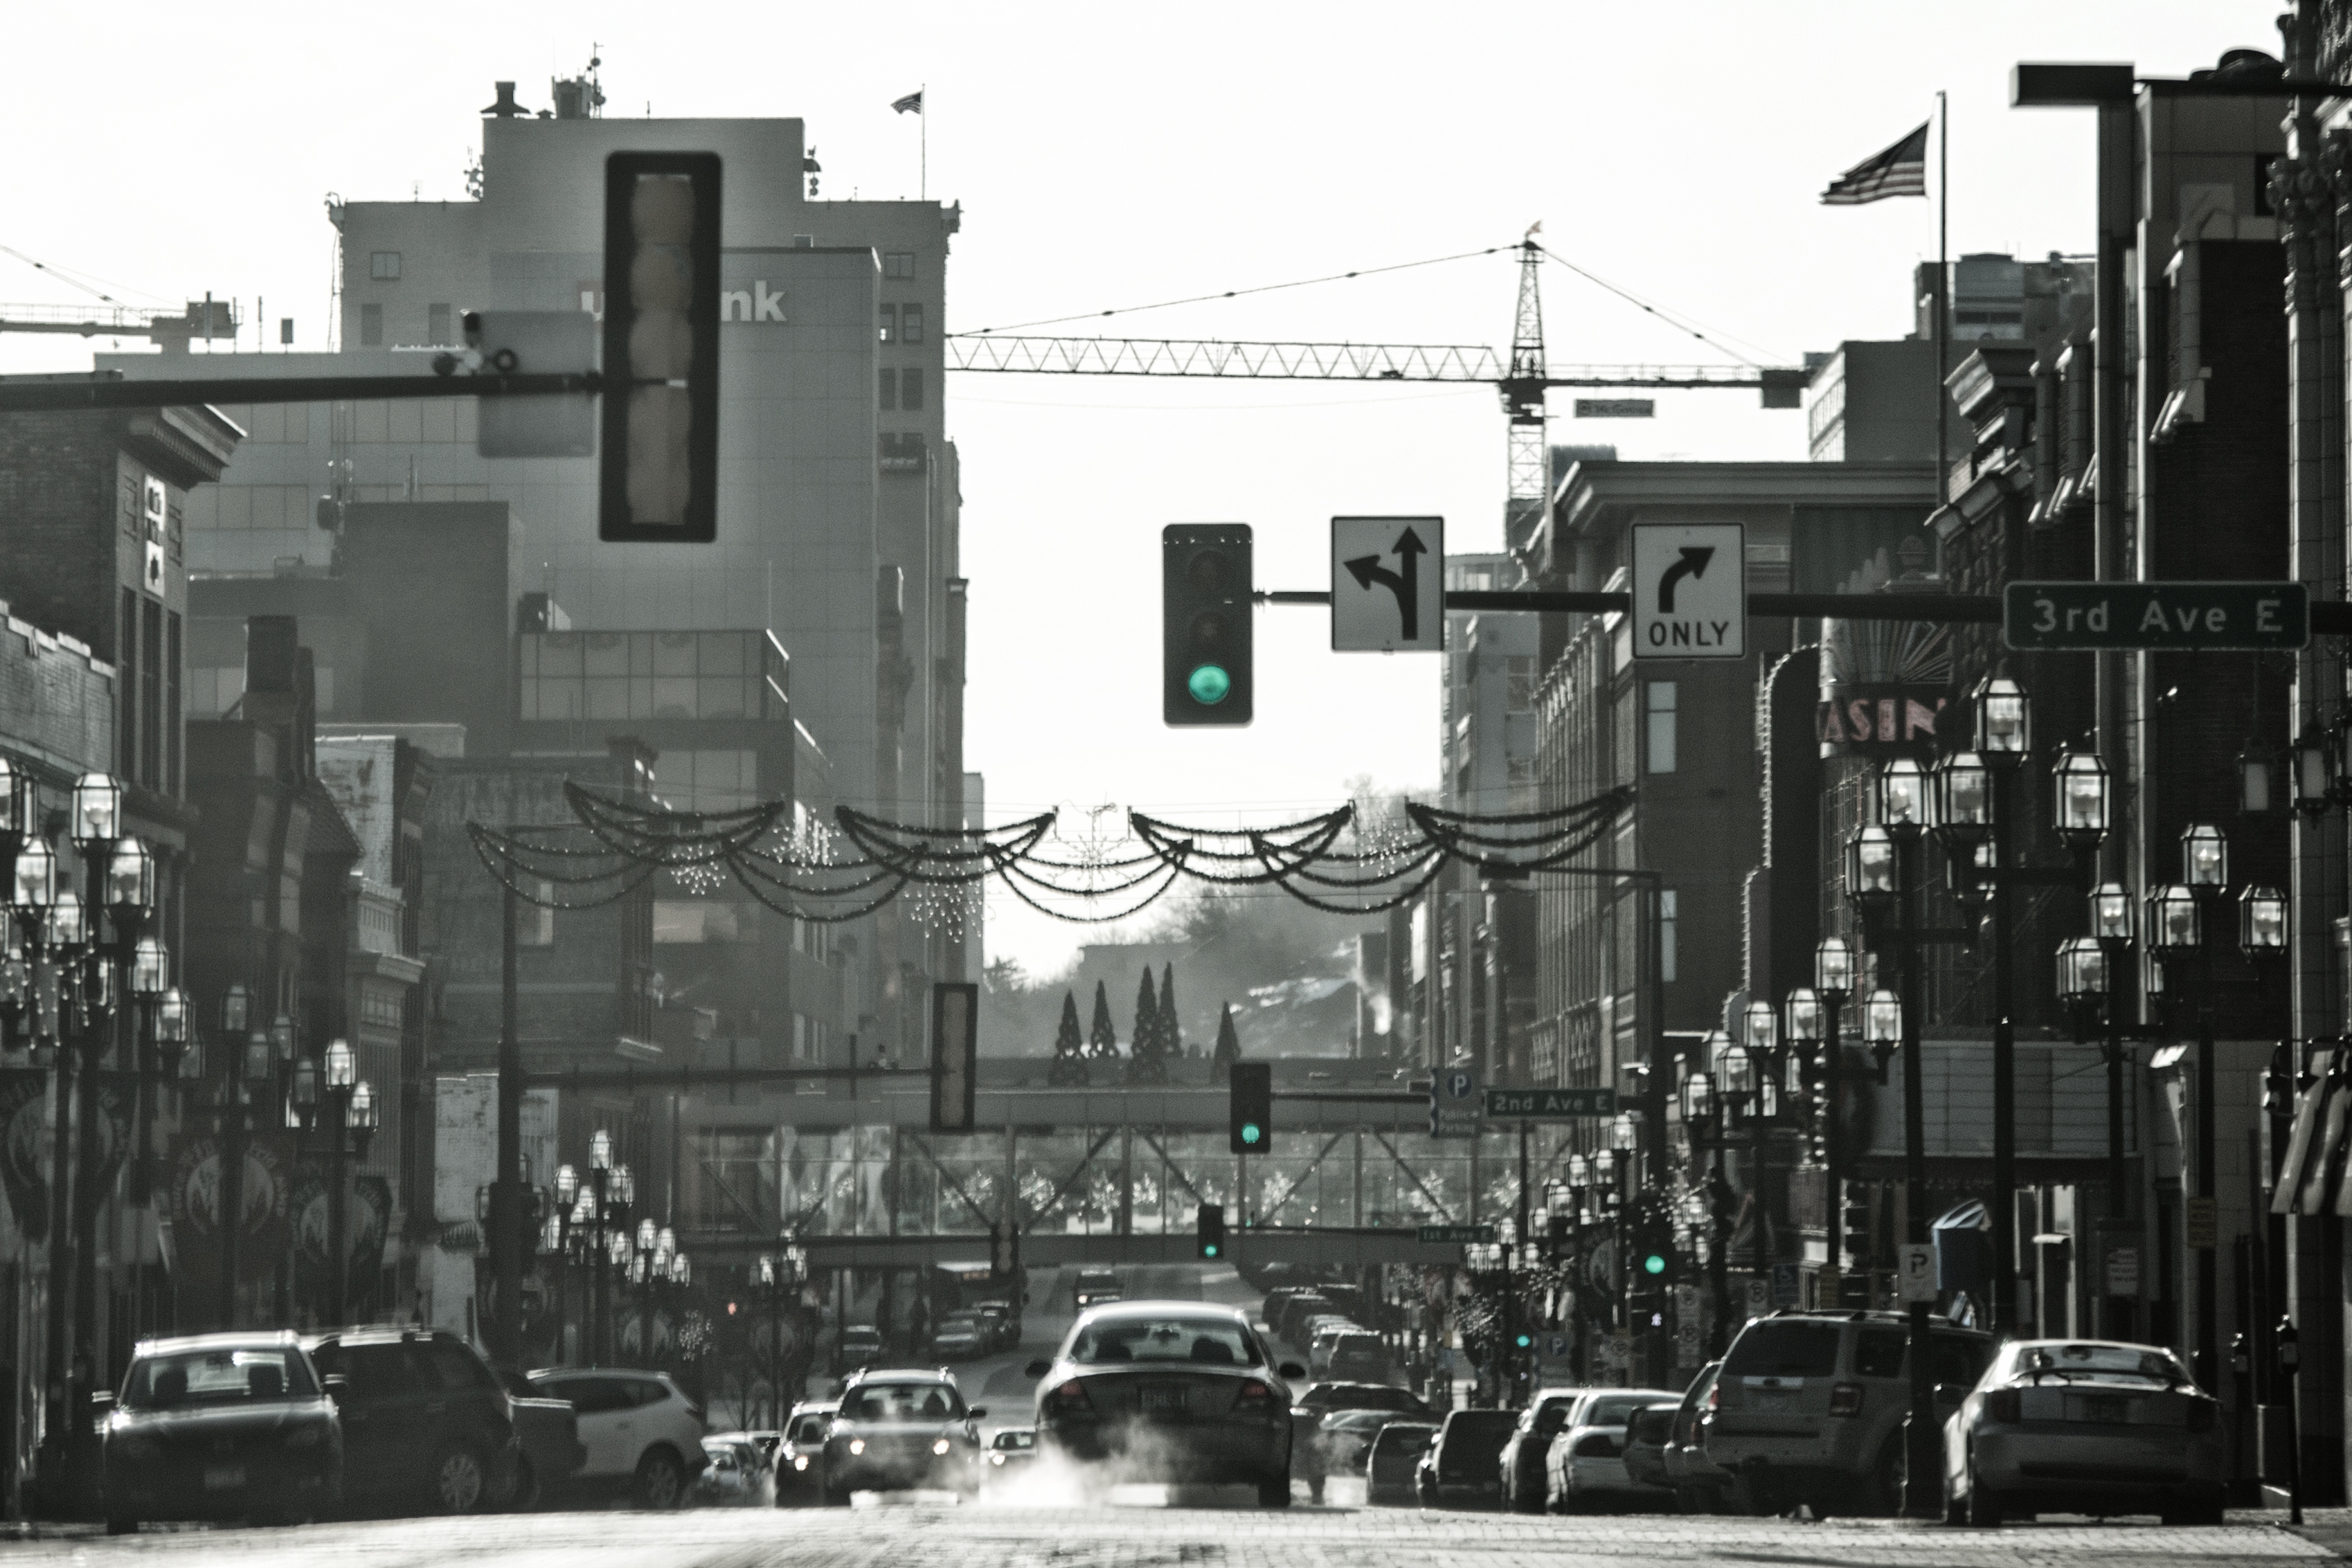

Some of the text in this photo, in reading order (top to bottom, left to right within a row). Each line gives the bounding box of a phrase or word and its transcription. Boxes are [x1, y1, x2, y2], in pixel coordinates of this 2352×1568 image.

[721, 280, 787, 321] nk
[2032, 599, 2283, 632] 3rd Ave E
[1649, 621, 1730, 647] ONLY
[1815, 698, 1946, 742] ASIN
[1455, 1074, 1466, 1097] P
[1495, 1094, 1608, 1110] 2nd Ave E
